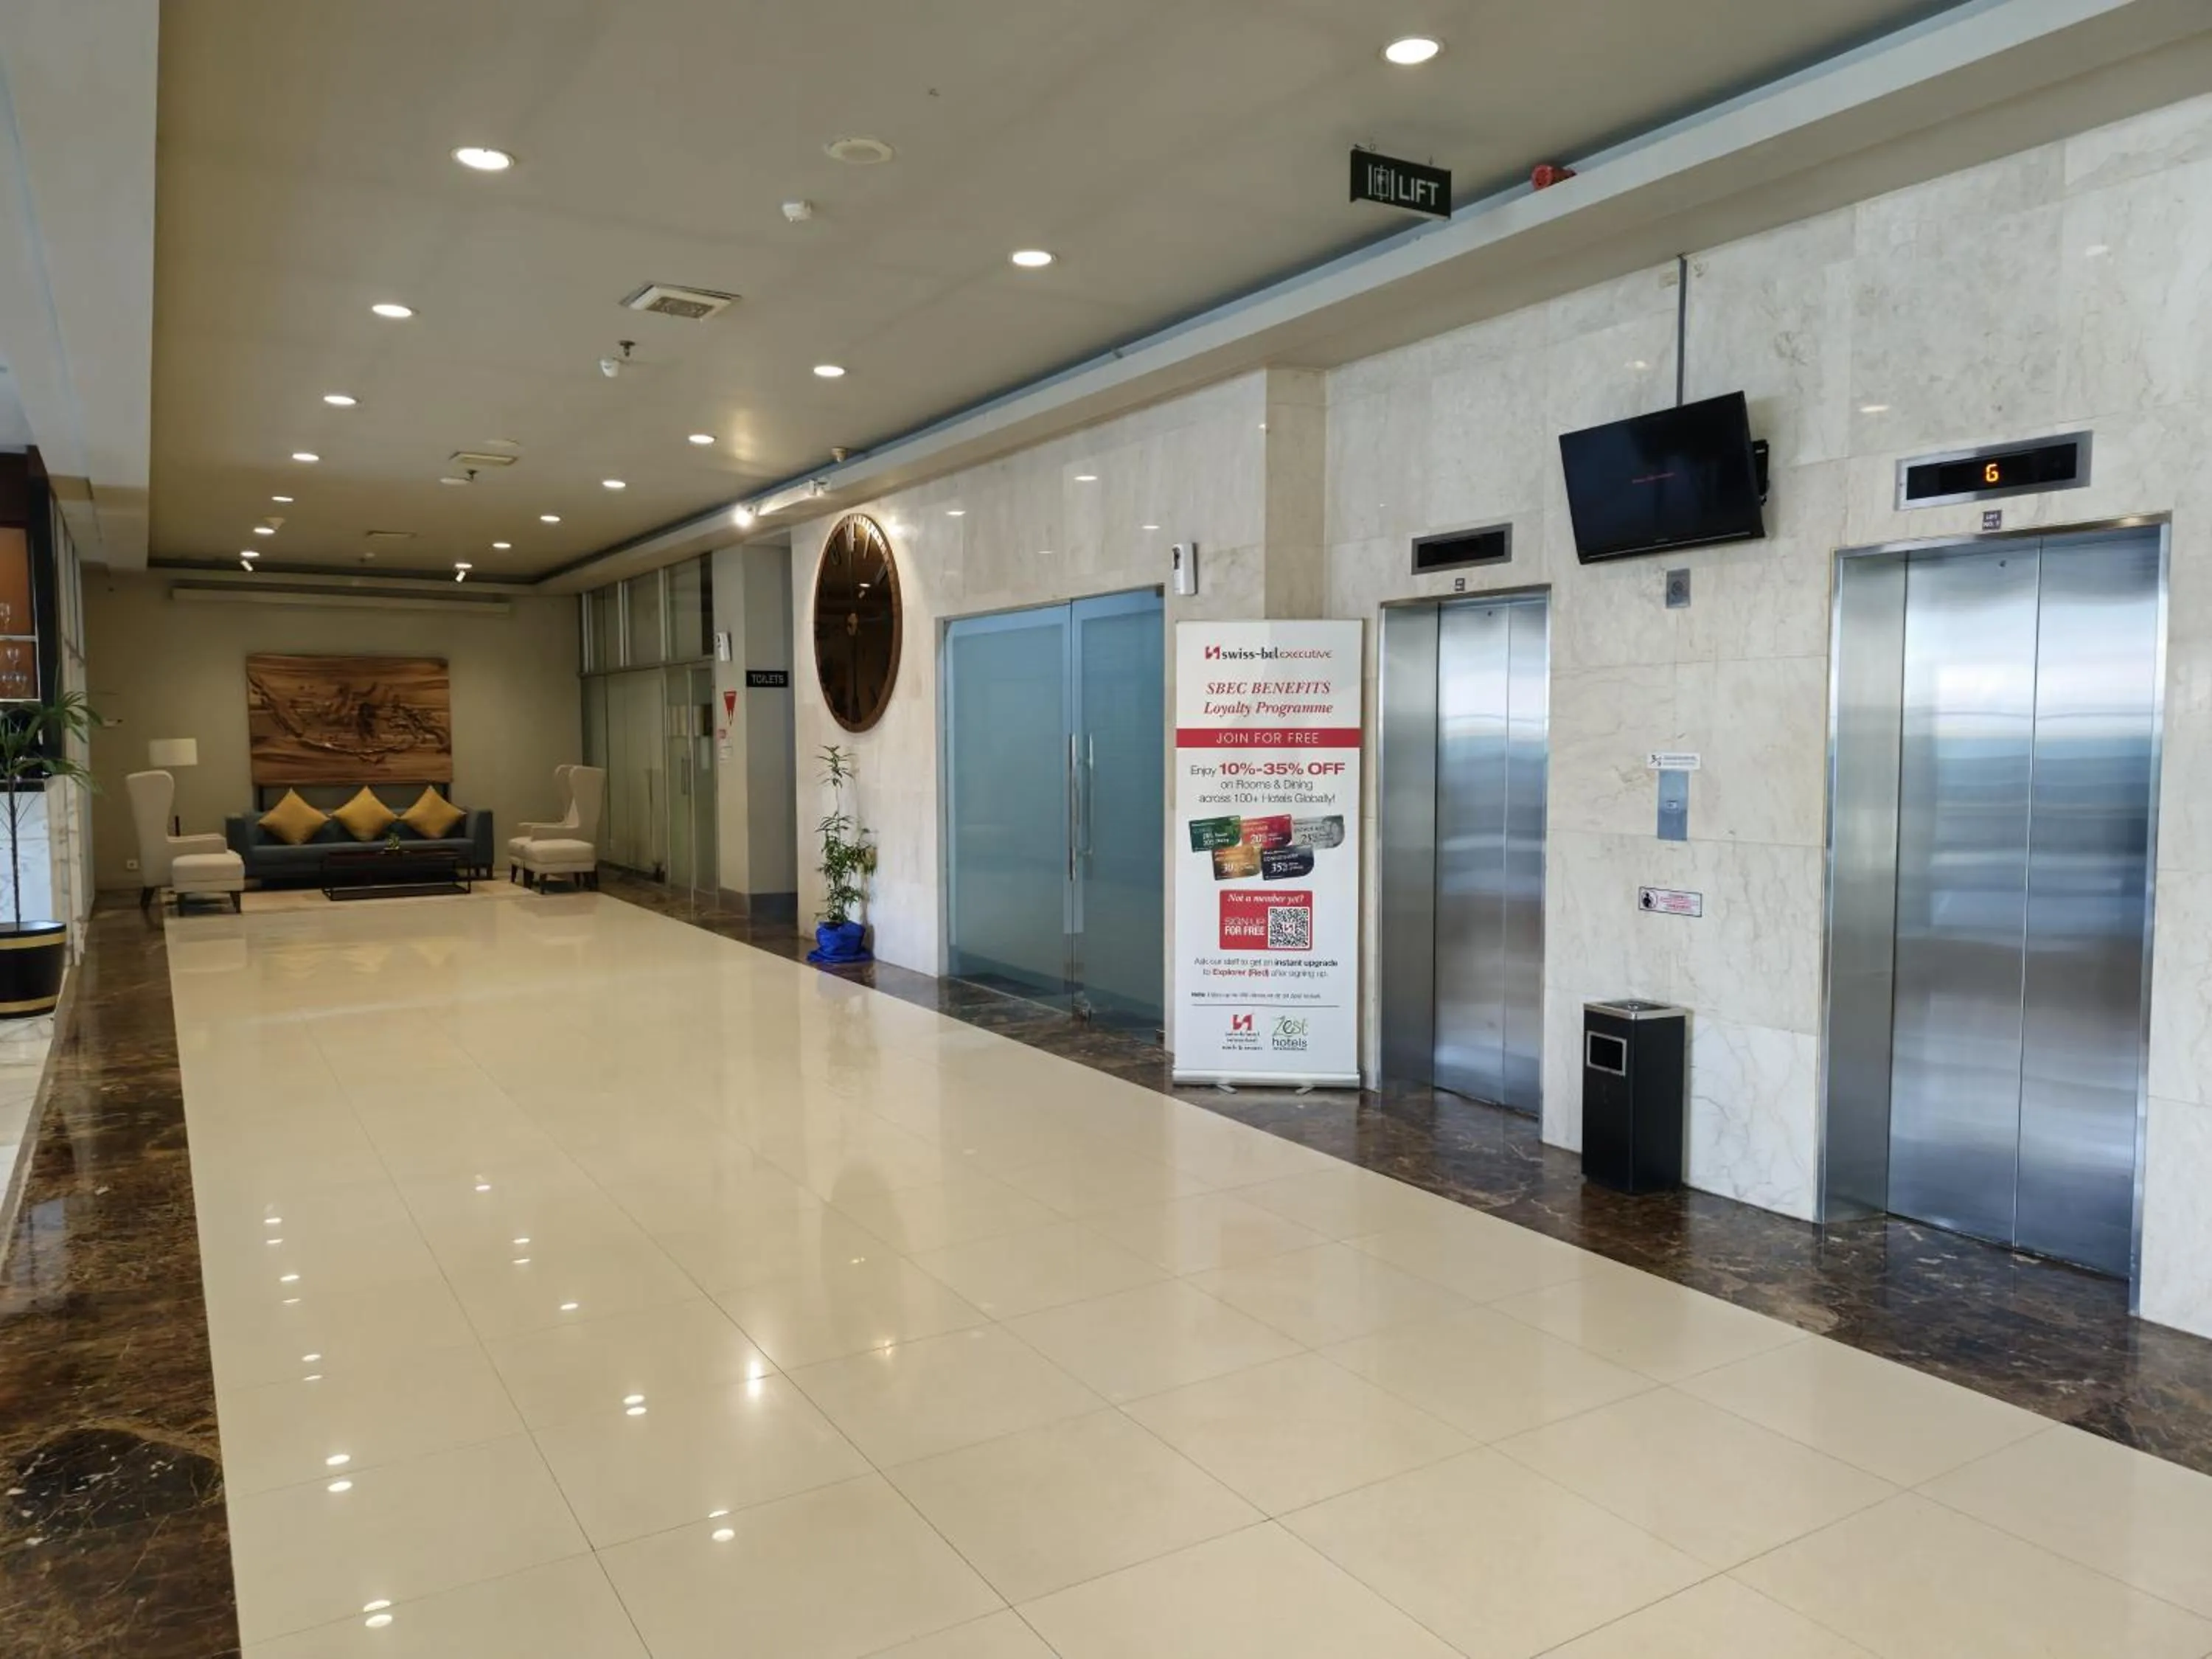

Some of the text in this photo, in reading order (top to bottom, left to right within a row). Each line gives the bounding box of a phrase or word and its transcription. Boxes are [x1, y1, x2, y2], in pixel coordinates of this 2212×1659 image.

[1398, 175, 1439, 206] LIFT
[751, 674, 785, 684] TOILETS
[1206, 681, 1332, 695] SBEC BENEFITS
[1203, 701, 1334, 718] Loyalty Programme
[1216, 731, 1320, 745] JOIN FOR FREE
[1190, 762, 1346, 778] Enjoy 10%-35% OFF
[1220, 779, 1313, 792] on Rooms & Dining
[1198, 793, 1336, 805] across 100+ Hotels Globally!
[1227, 893, 1245, 902] Not
[1253, 893, 1286, 903] member
[1287, 894, 1305, 905] yet?
[1225, 925, 1265, 936] FOR FREE
[1250, 959, 1262, 968] get
[1274, 959, 1302, 967] instant
[1303, 959, 1338, 967] upgrade
[1212, 968, 1246, 977] Explorer
[1271, 1015, 1309, 1037] Zest
[1271, 1037, 1308, 1048] hotels
